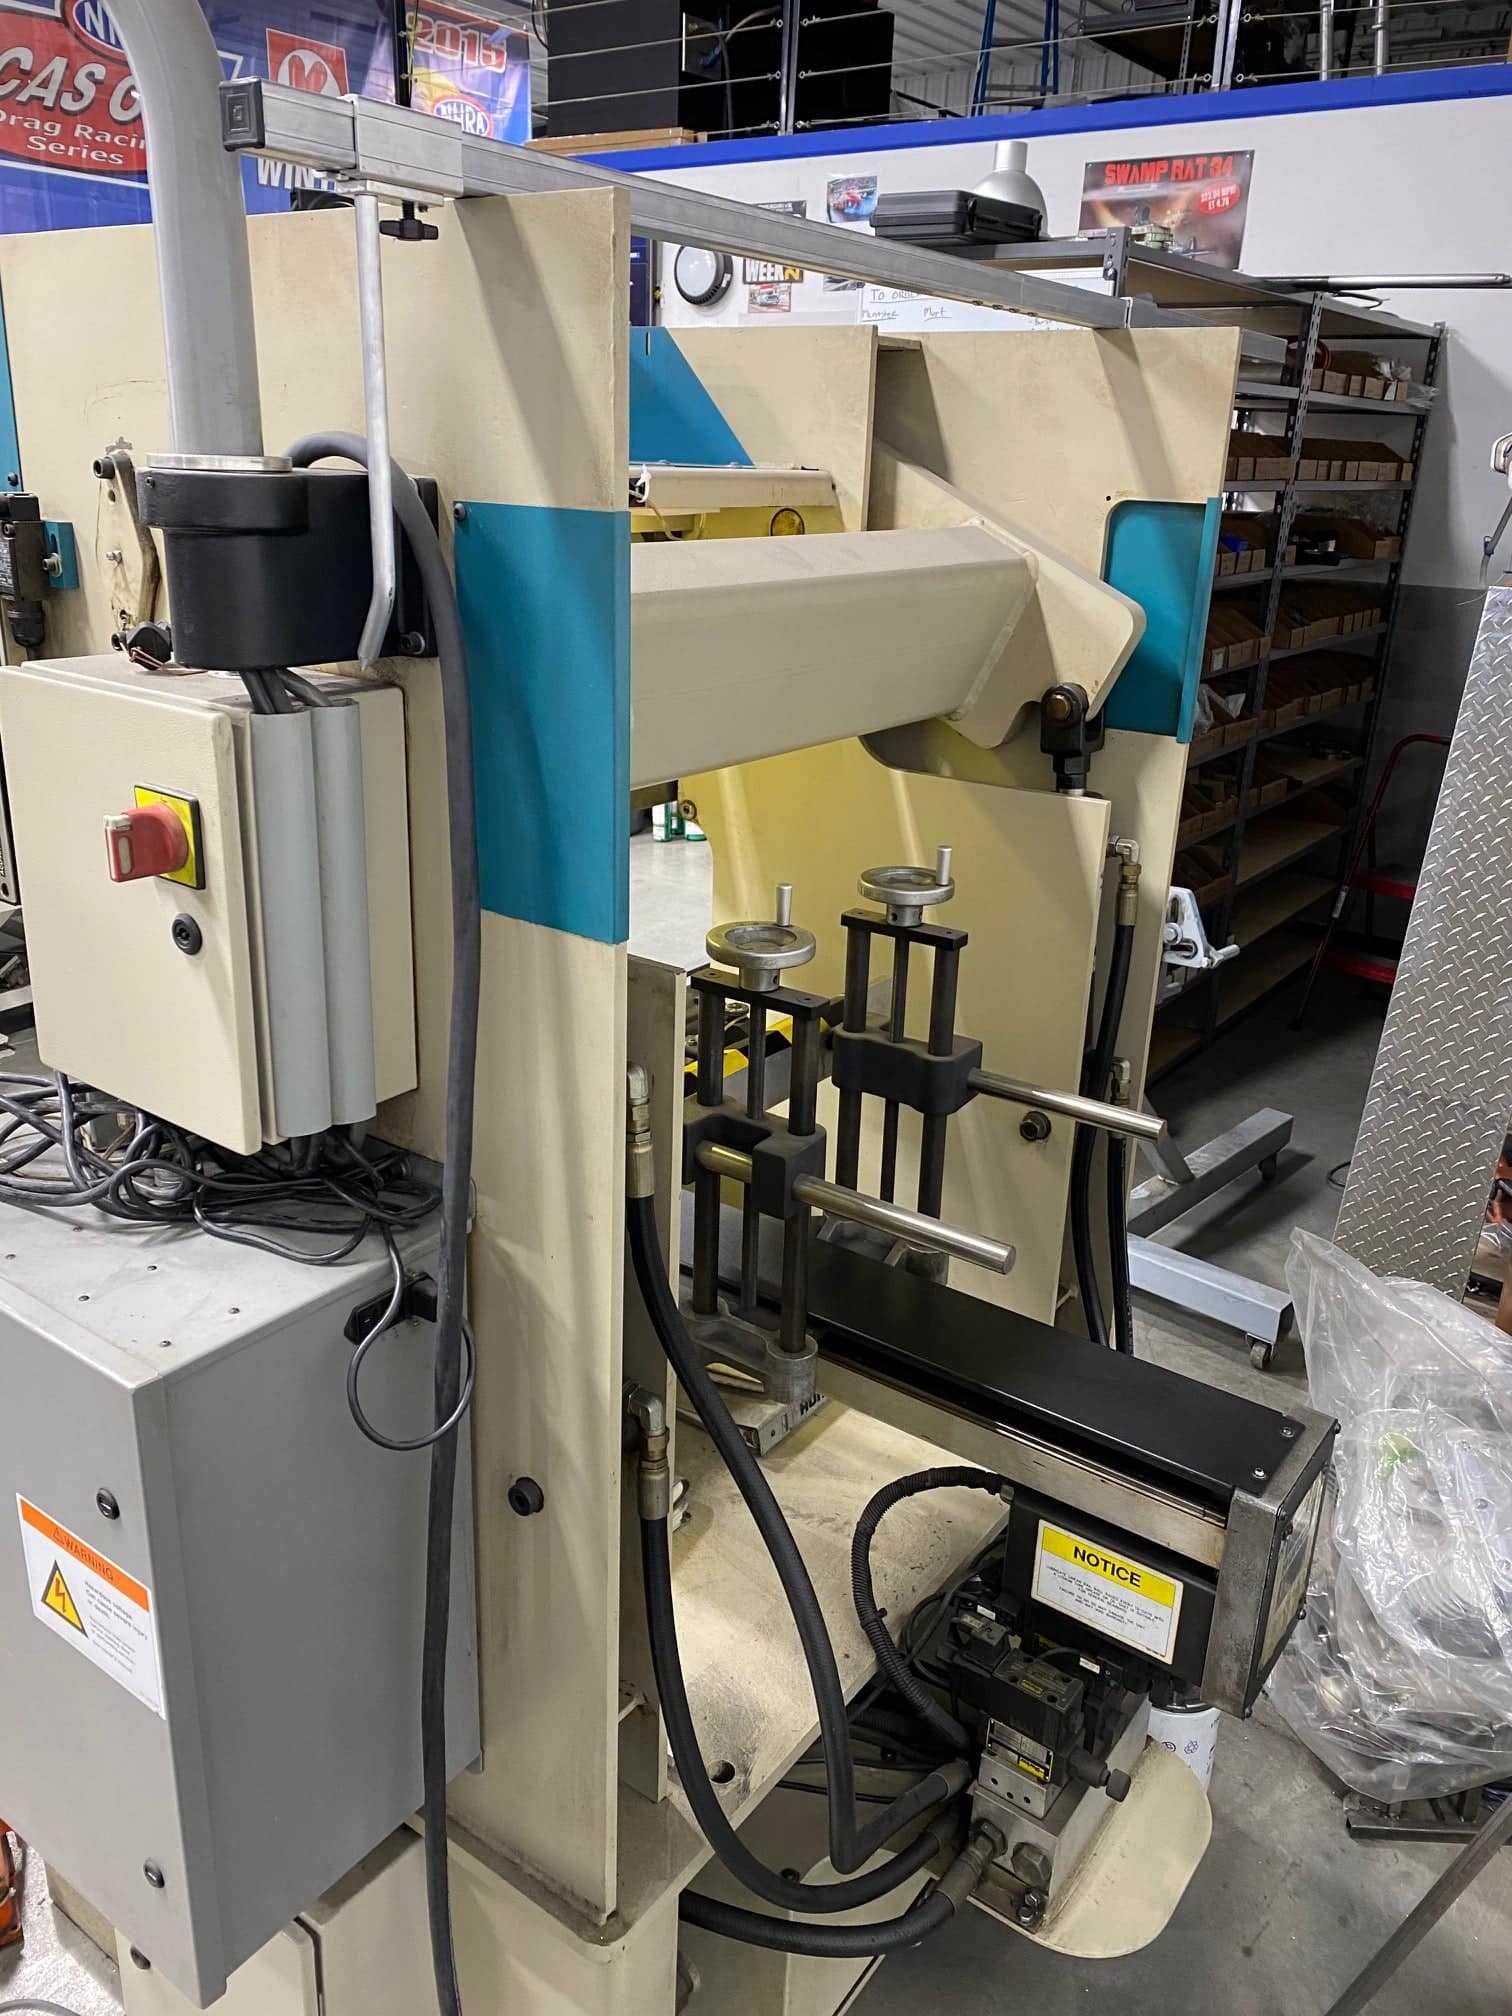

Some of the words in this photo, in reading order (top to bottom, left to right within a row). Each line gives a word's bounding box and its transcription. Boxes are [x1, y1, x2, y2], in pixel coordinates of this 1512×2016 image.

[27, 135, 125, 165] Series
[73, 124, 145, 149] Raci
[1104, 160, 1168, 185] SWAMP
[1170, 157, 1208, 181] RAT
[1209, 155, 1234, 178] 34
[1074, 1546, 1141, 1588] NOTICE
